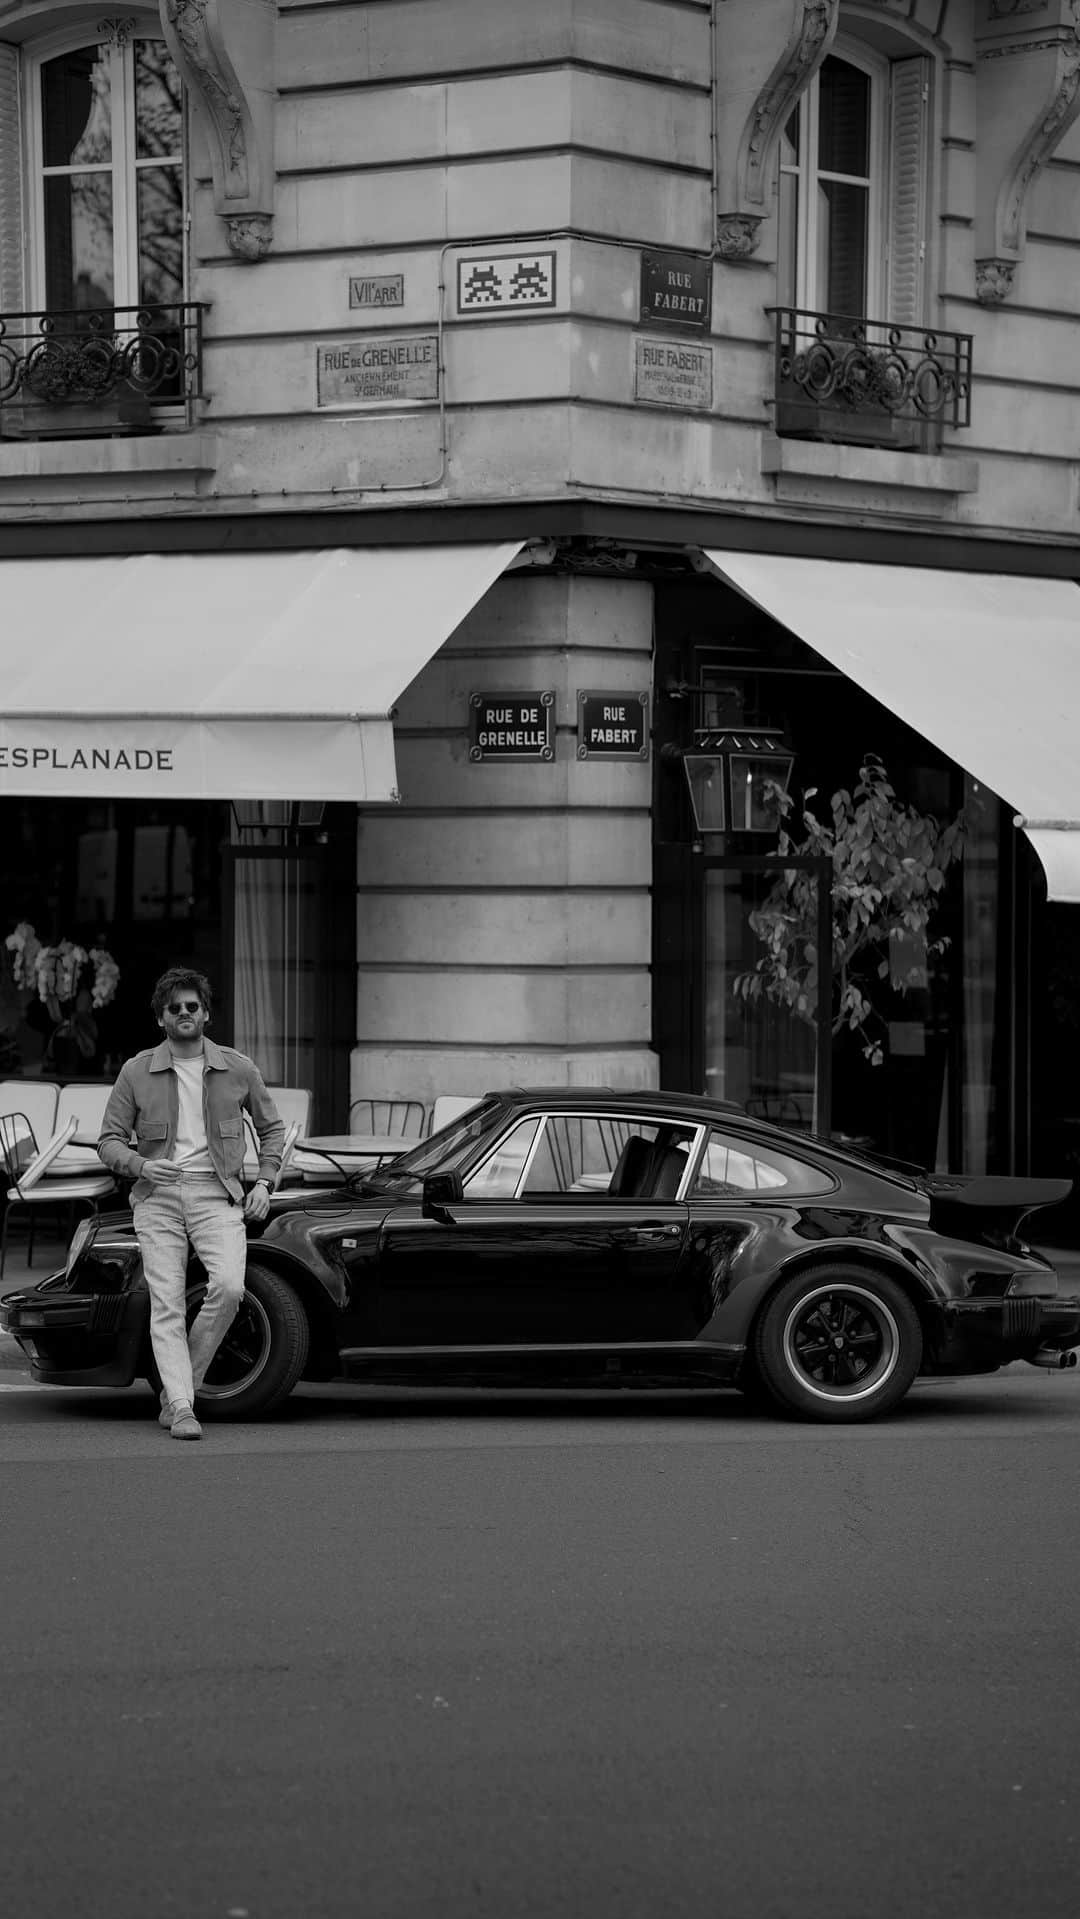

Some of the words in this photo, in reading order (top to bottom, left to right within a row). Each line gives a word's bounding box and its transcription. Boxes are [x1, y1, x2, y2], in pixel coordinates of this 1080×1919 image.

[668, 271, 692, 289] RUE
[654, 292, 705, 313] FABERT
[324, 351, 350, 371] RUE
[362, 345, 432, 367] GRENELLE
[643, 348, 664, 367] RUE
[666, 350, 705, 372] FABERT
[486, 709, 513, 723] RUE
[520, 709, 538, 723] DE
[603, 707, 626, 721] RUE
[479, 731, 545, 746] GRENELLE
[591, 728, 637, 743] FABERT
